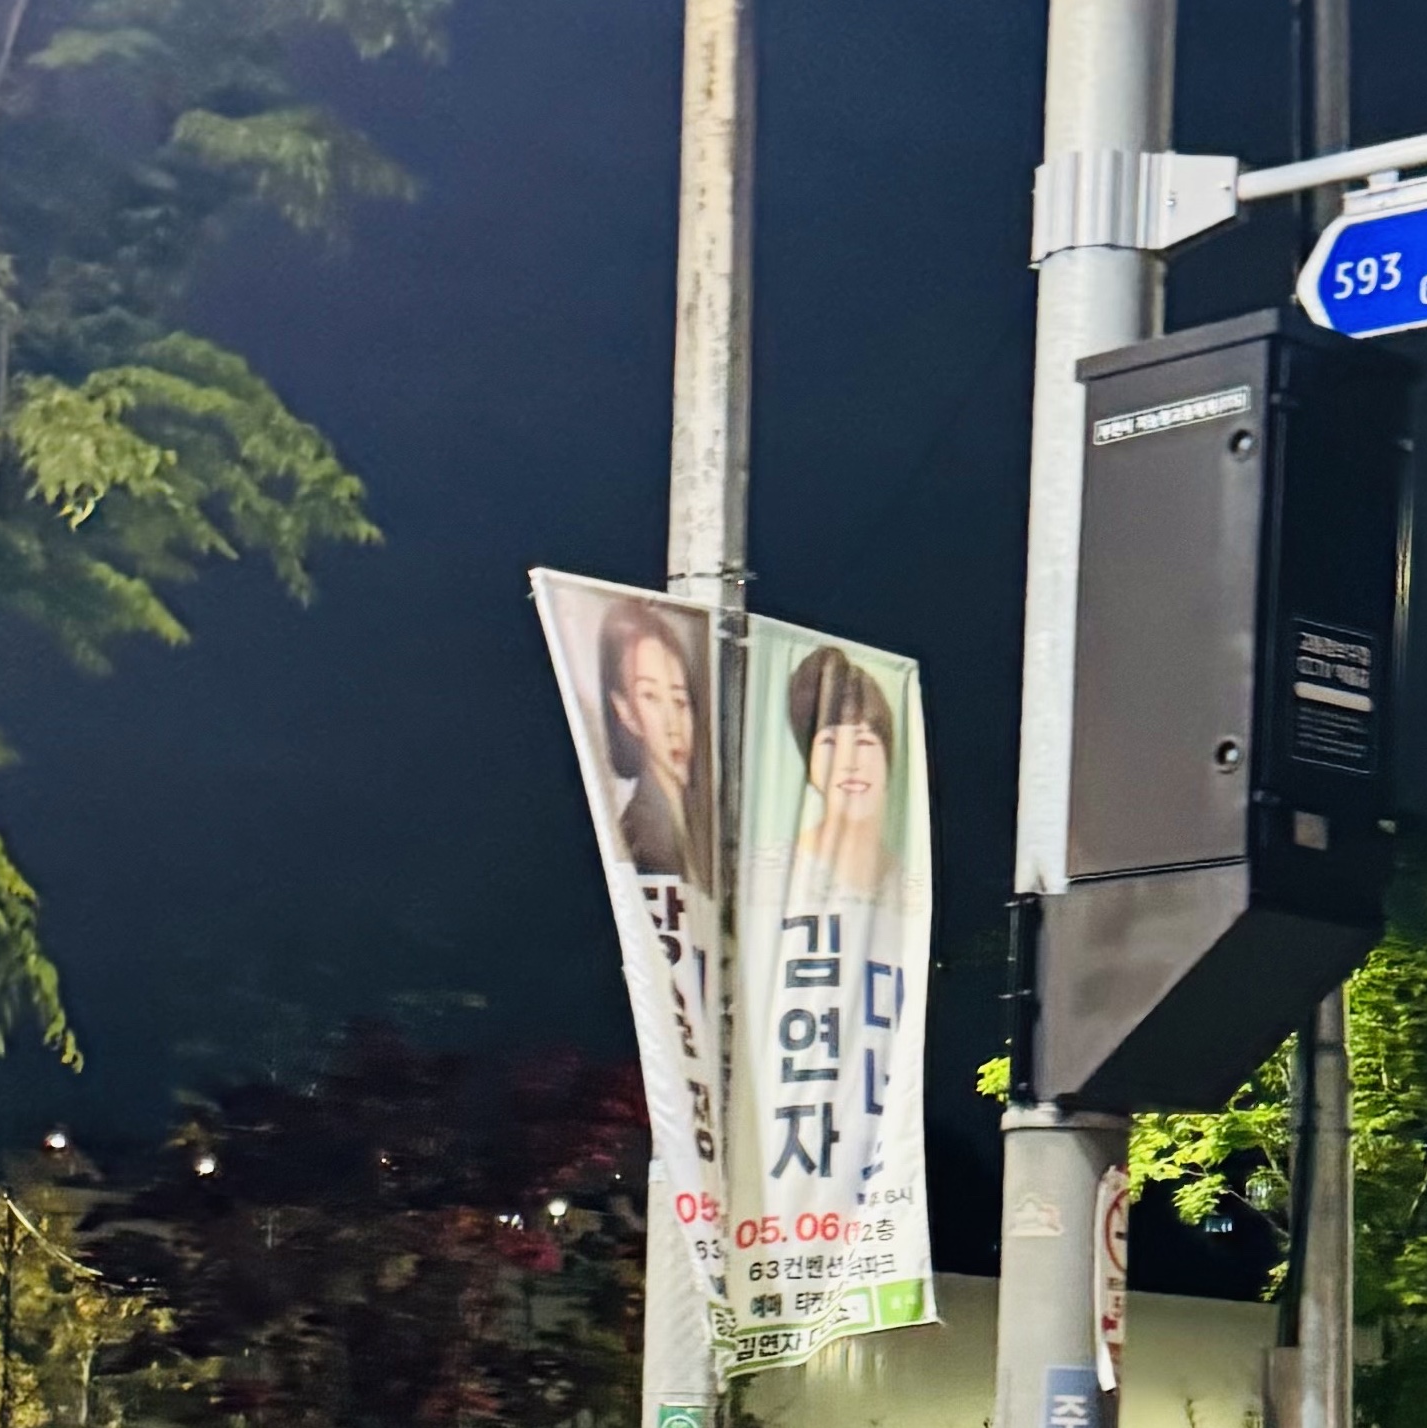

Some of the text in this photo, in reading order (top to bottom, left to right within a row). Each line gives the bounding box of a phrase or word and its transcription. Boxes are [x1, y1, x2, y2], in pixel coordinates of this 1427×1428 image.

[1334, 252, 1401, 299] 593
[770, 914, 841, 1179] 김연자
[737, 1333, 802, 1362] 김연자
